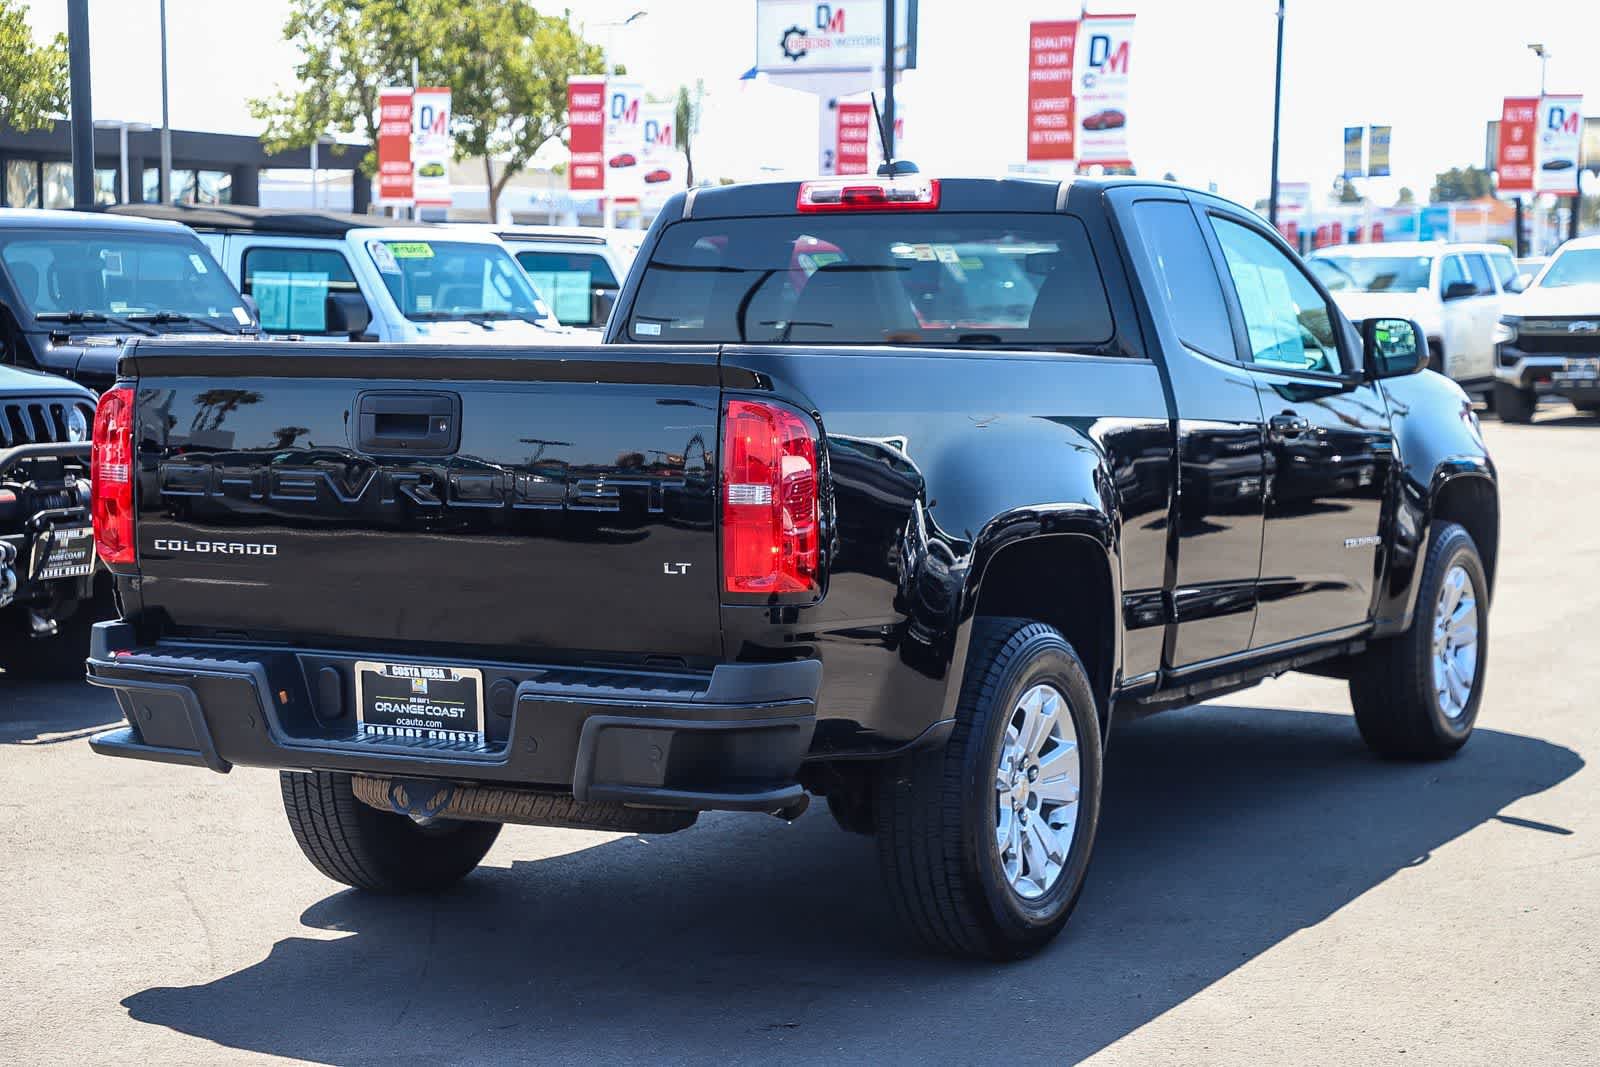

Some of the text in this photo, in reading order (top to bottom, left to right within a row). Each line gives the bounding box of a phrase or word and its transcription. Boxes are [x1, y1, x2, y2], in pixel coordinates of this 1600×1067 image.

[1088, 34, 1130, 74] DM
[159, 463, 687, 513] CHEVROLET
[153, 539, 278, 556] COLORADO
[663, 562, 692, 575] LT
[391, 665, 446, 679] COSTA MESA
[374, 702, 466, 718] ORANGE COAST
[396, 718, 442, 728] ocauto.com
[367, 725, 476, 742] ORANGE COAST
